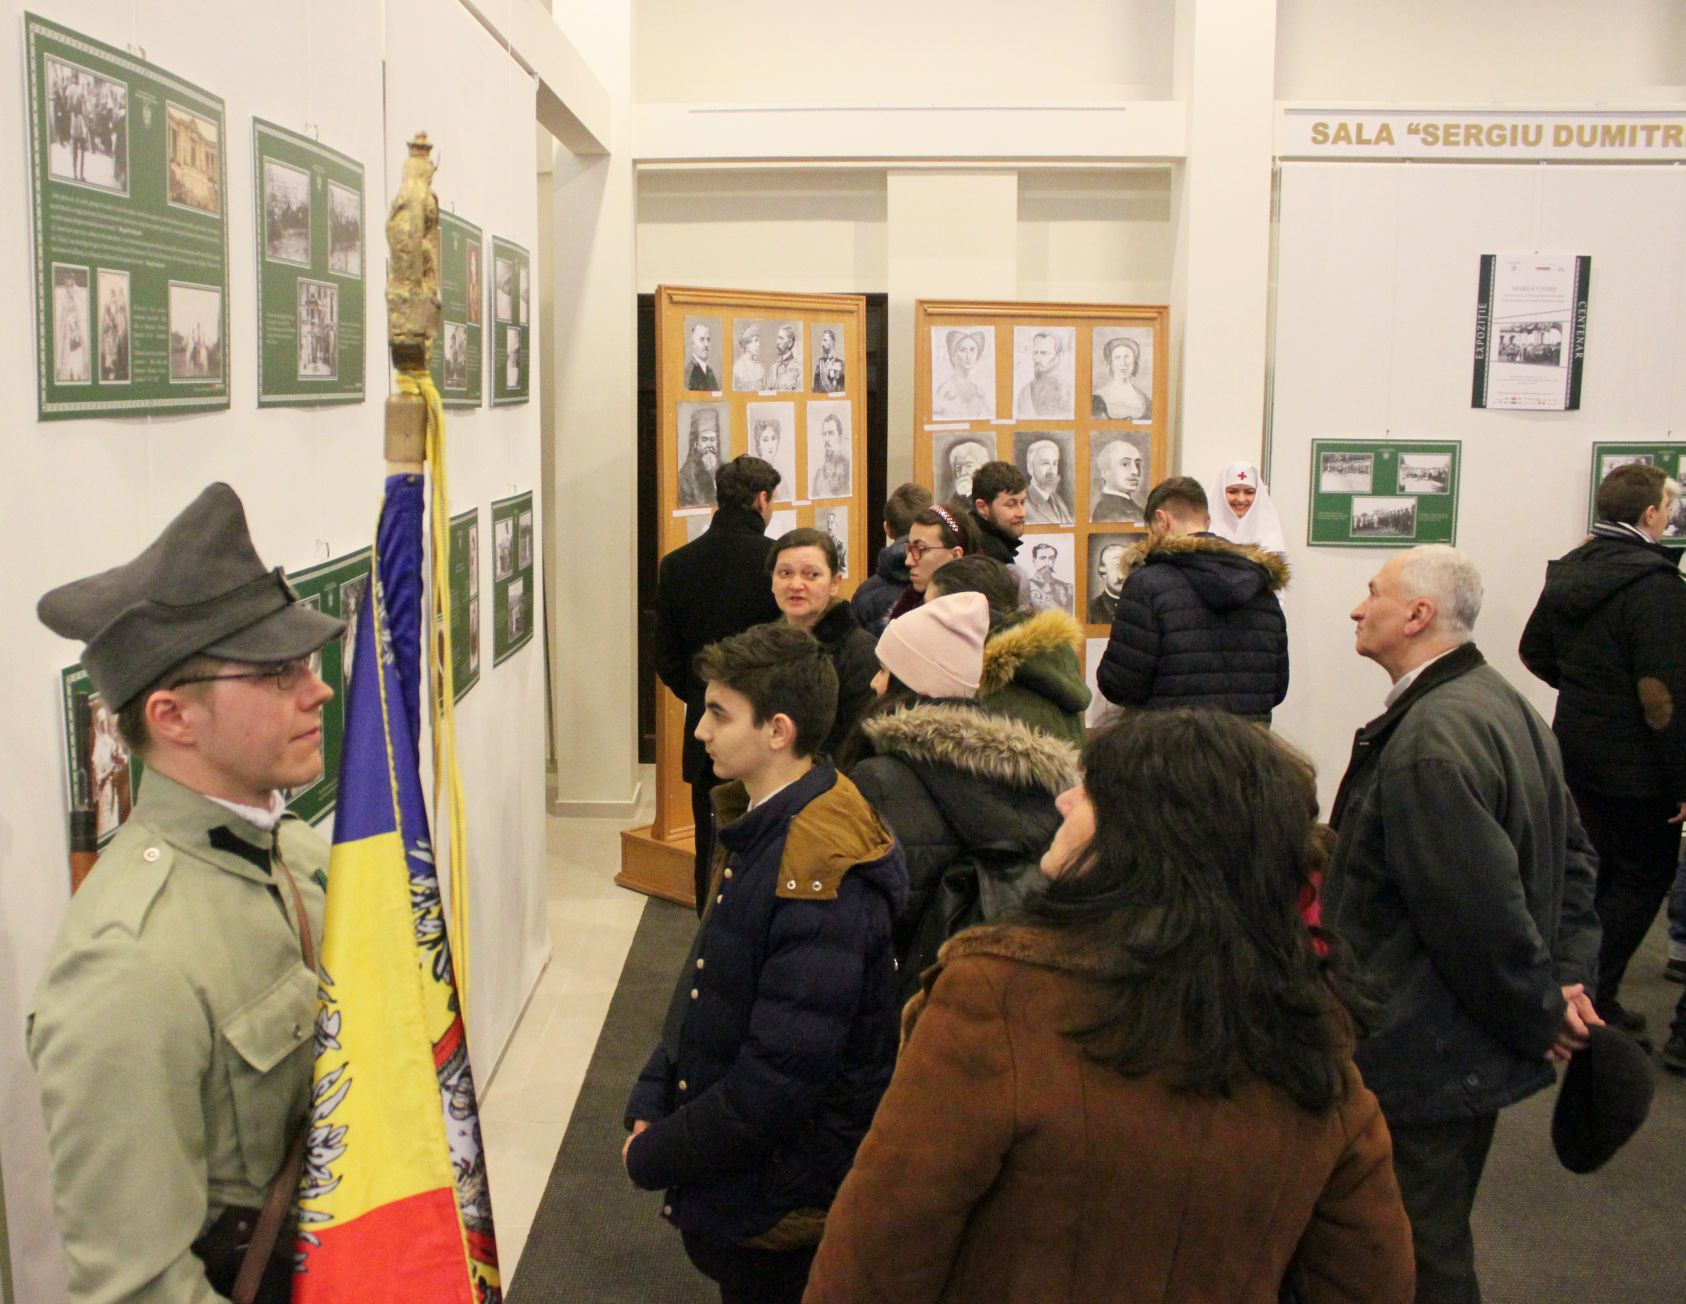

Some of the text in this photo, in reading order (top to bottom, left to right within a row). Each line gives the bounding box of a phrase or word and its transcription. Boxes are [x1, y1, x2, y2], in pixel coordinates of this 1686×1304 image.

[1311, 122, 1396, 146] SALA
[1553, 124, 1686, 149] DUMITR
[1574, 301, 1587, 359] CENTENAR
